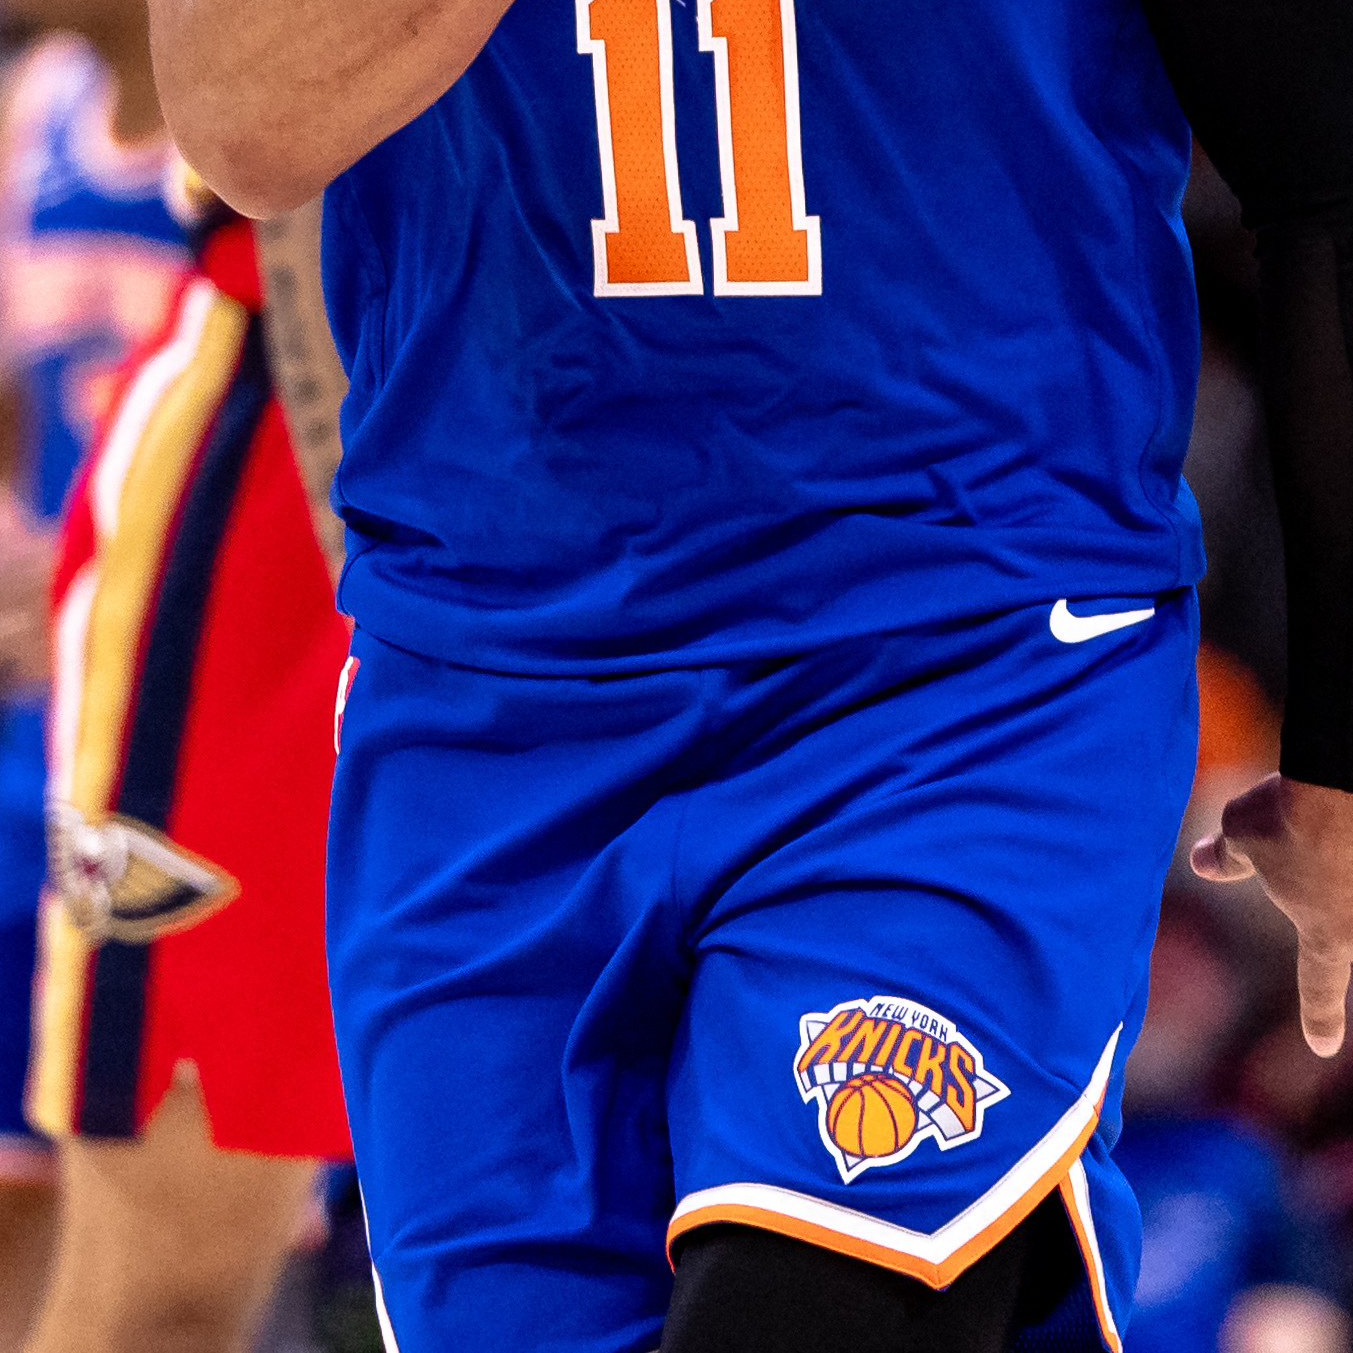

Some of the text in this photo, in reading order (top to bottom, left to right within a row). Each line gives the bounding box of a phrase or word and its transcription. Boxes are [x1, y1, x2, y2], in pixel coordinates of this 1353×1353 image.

[869, 1002, 949, 1042] NEW YORK
[797, 1007, 977, 1133] KNICKS
